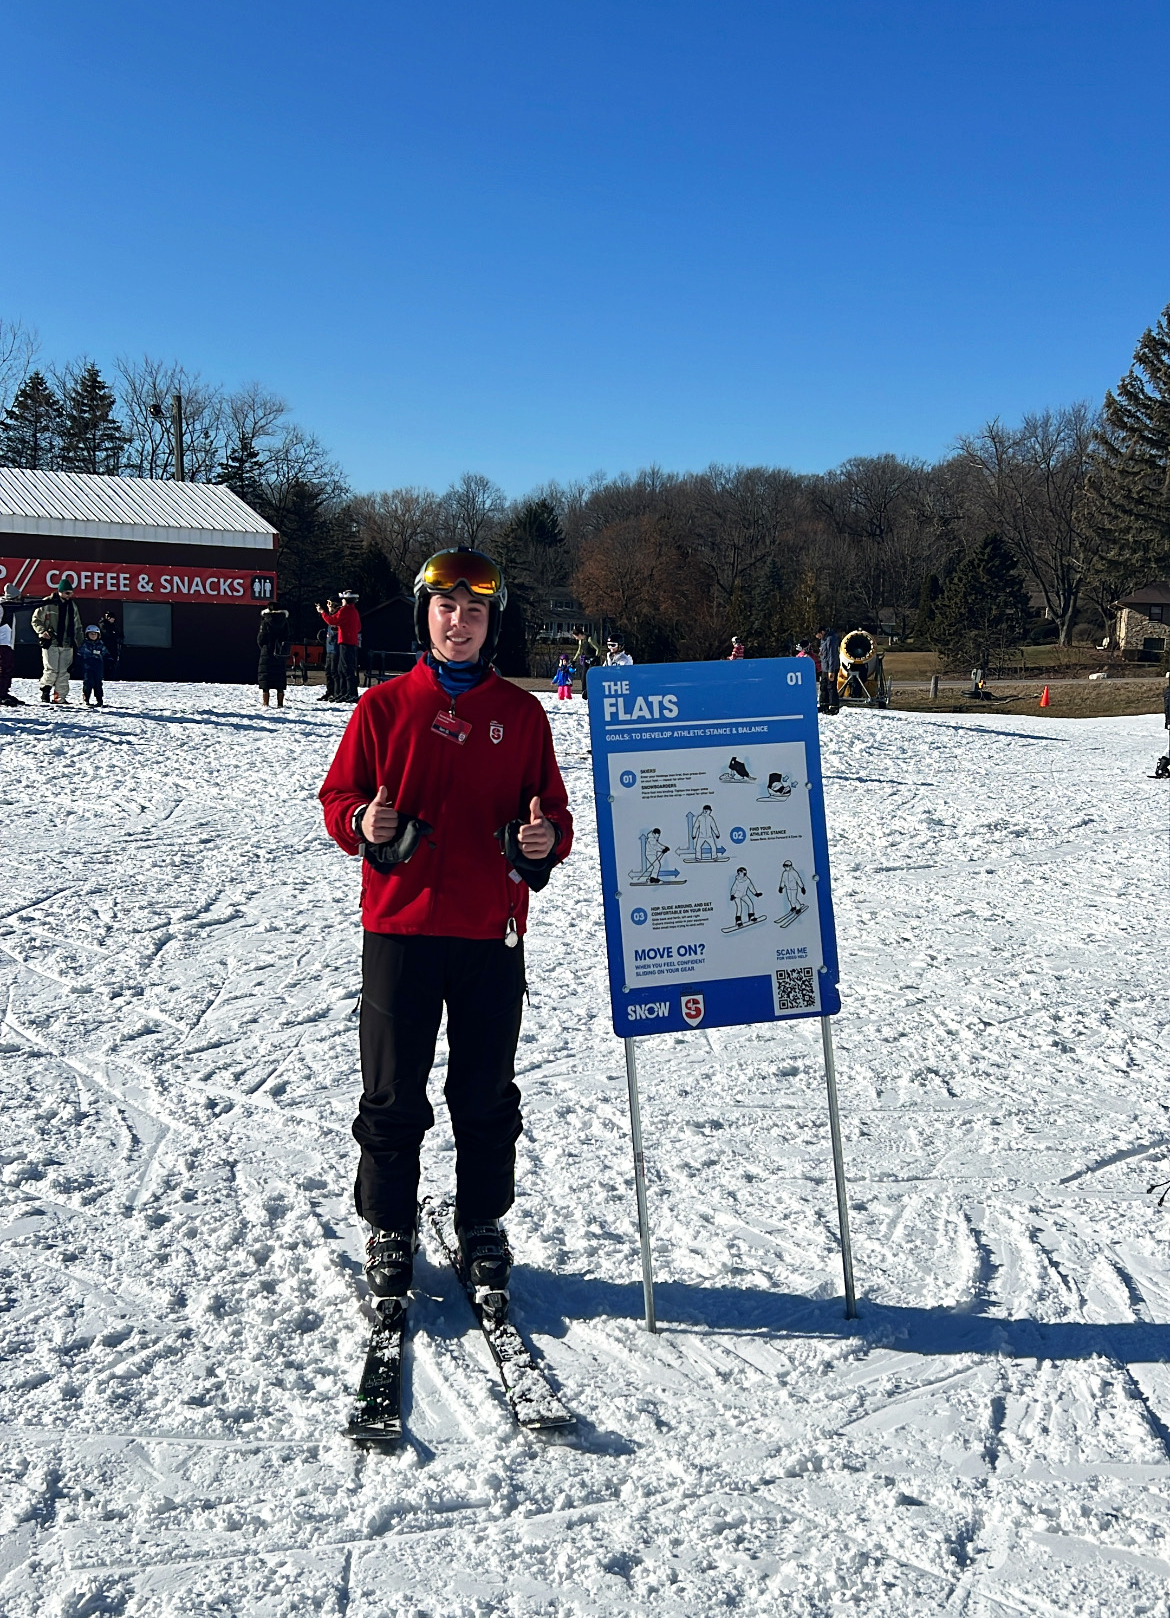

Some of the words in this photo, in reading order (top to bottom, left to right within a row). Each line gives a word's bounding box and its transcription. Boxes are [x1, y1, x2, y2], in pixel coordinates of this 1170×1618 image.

[46, 570, 130, 592] COFFEE
[137, 574, 154, 592] &
[160, 575, 244, 596] SNACKS
[786, 672, 803, 685] 01
[602, 681, 630, 695] THE
[603, 694, 679, 721] FLATS
[605, 734, 631, 742] GOALS:
[642, 731, 672, 739] DEVELOP
[673, 729, 705, 737] ATHLETIC
[706, 727, 731, 736] STANCE
[738, 725, 769, 734] BALANCE
[623, 775, 633, 784] 01
[732, 831, 744, 840] 02
[634, 912, 645, 920] 03
[634, 946, 673, 961] MOVE
[677, 943, 706, 957] ON?
[776, 948, 796, 957] SCAN
[797, 946, 808, 955] ME
[677, 958, 706, 966] CONFIDENT
[627, 1001, 670, 1020] SNOW
